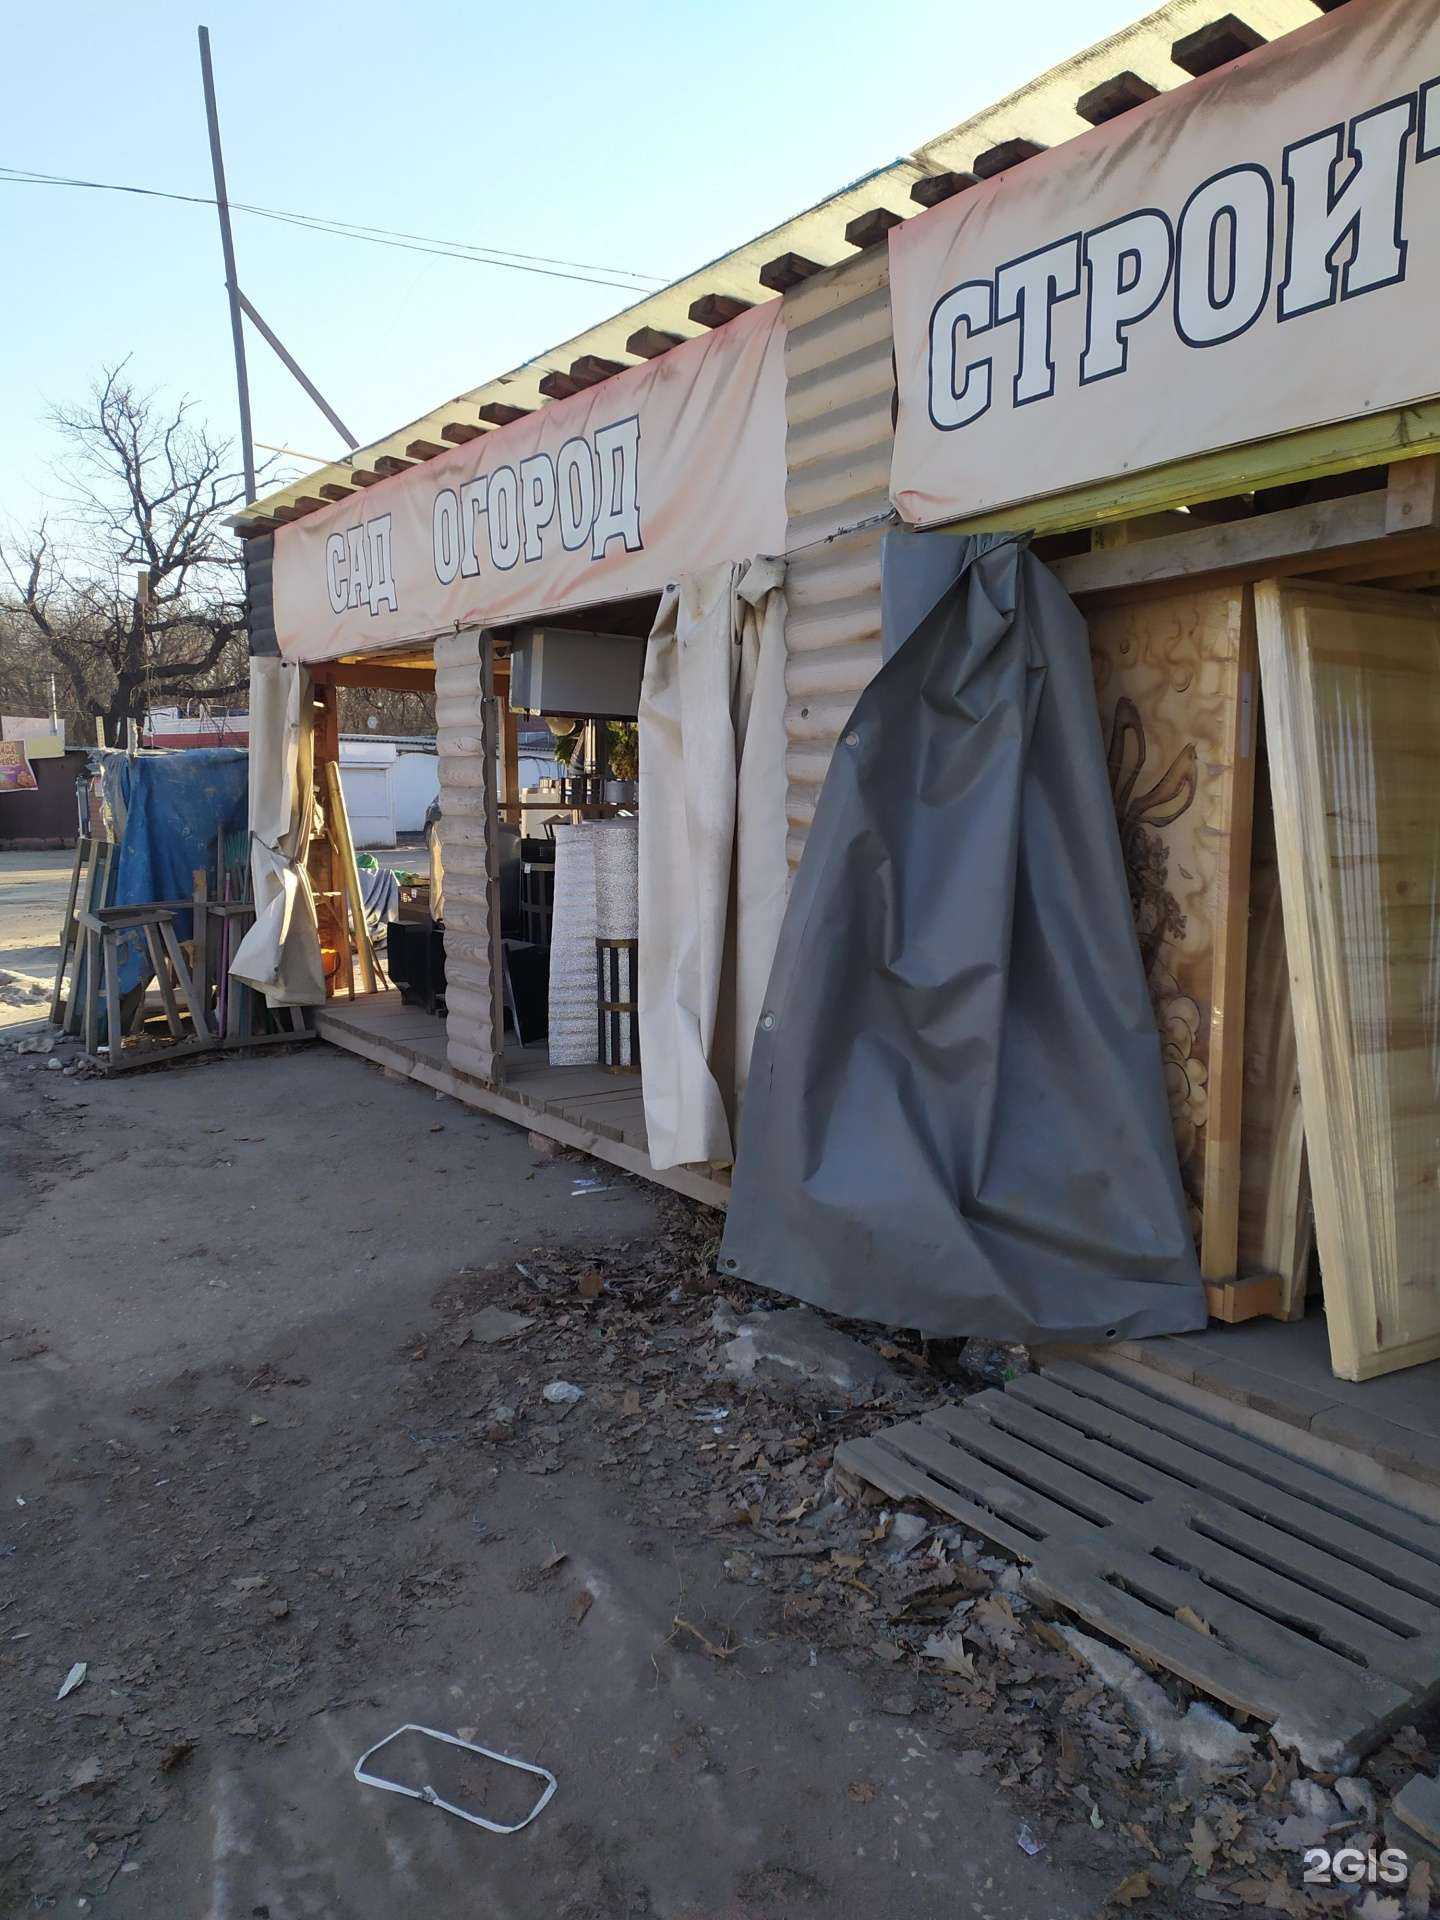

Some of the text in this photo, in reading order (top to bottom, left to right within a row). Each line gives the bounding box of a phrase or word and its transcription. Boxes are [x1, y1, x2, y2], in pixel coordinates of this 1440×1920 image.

[928, 75, 1440, 431] СТРОИ
[325, 414, 644, 617] САД ОГОРОД
